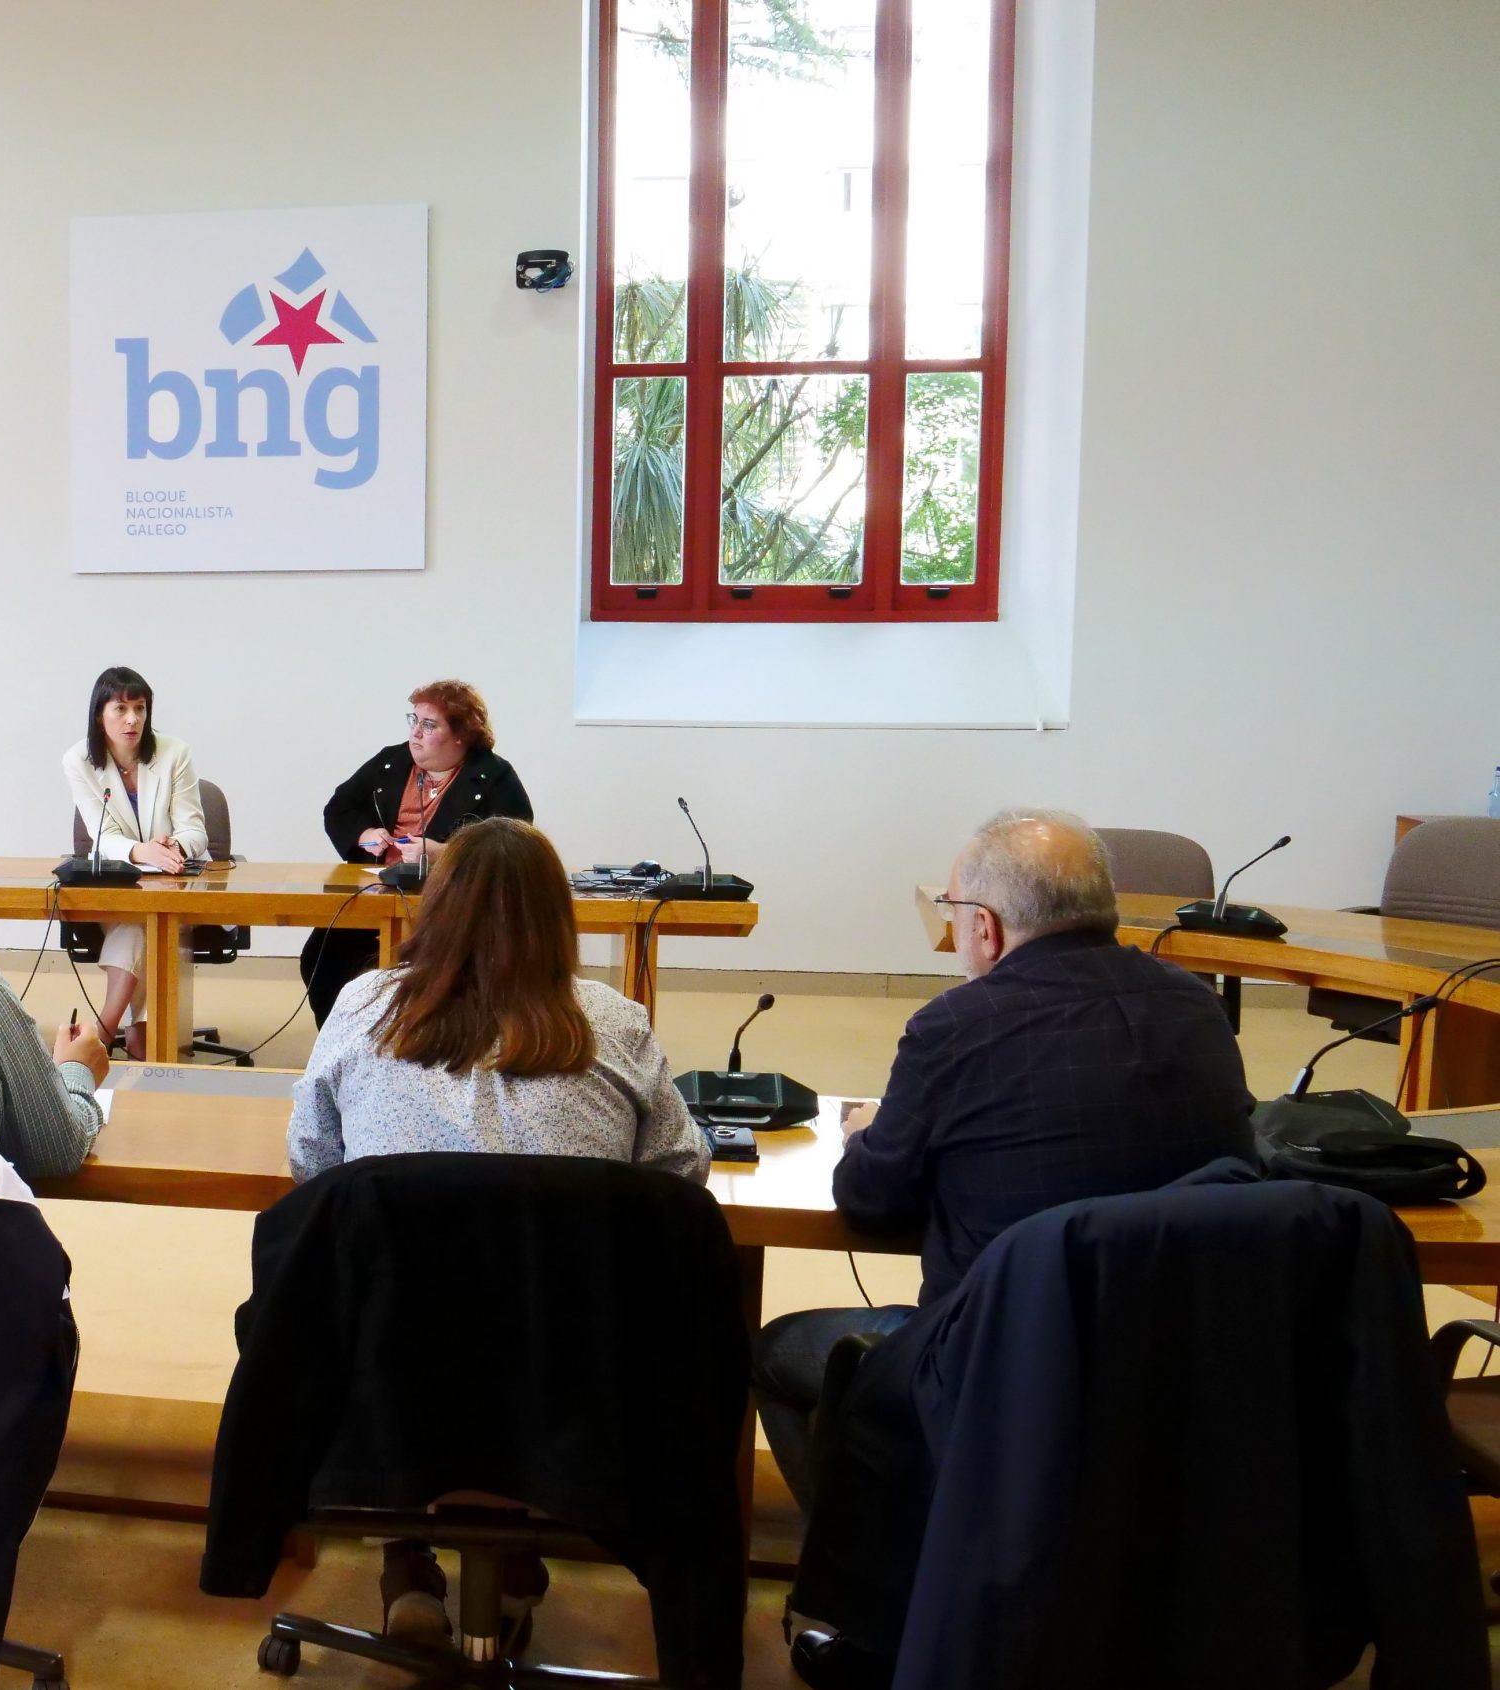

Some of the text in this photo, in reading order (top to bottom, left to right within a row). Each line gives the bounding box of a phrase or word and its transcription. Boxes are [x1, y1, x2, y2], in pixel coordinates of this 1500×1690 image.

[115, 337, 380, 490] bng
[126, 490, 187, 503] BLOQUE
[126, 506, 234, 519] NACIONALISTA
[126, 523, 187, 536] GALEGO
